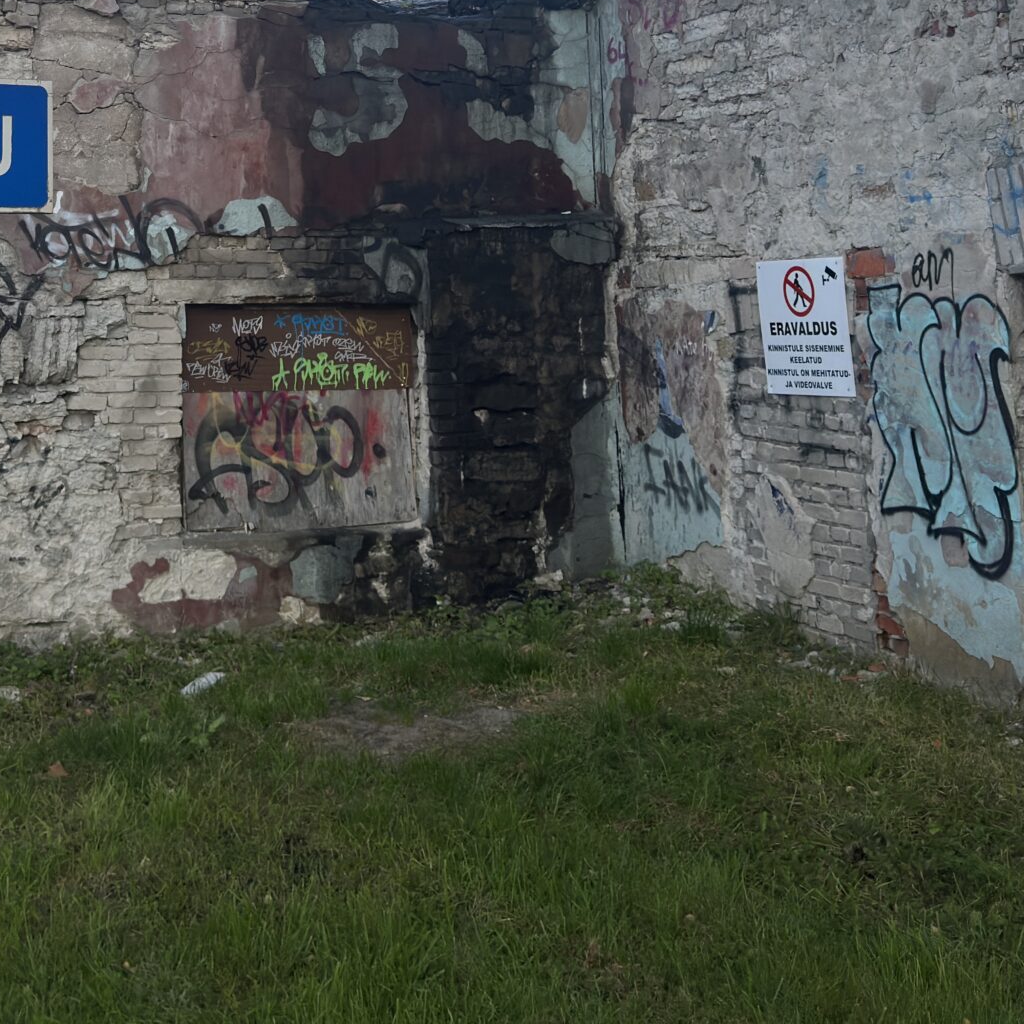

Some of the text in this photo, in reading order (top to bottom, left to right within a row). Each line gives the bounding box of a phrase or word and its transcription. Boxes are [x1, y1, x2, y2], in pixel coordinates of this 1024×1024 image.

[769, 321, 838, 336] ERAVALDUS
[767, 344, 845, 353] KINNISTULE SISENEMINE
[789, 356, 823, 364] KEELATUD
[767, 368, 800, 377] KINNISTUL
[800, 369, 810, 377] ON
[785, 380, 833, 390] JA VIDEOVALVE
